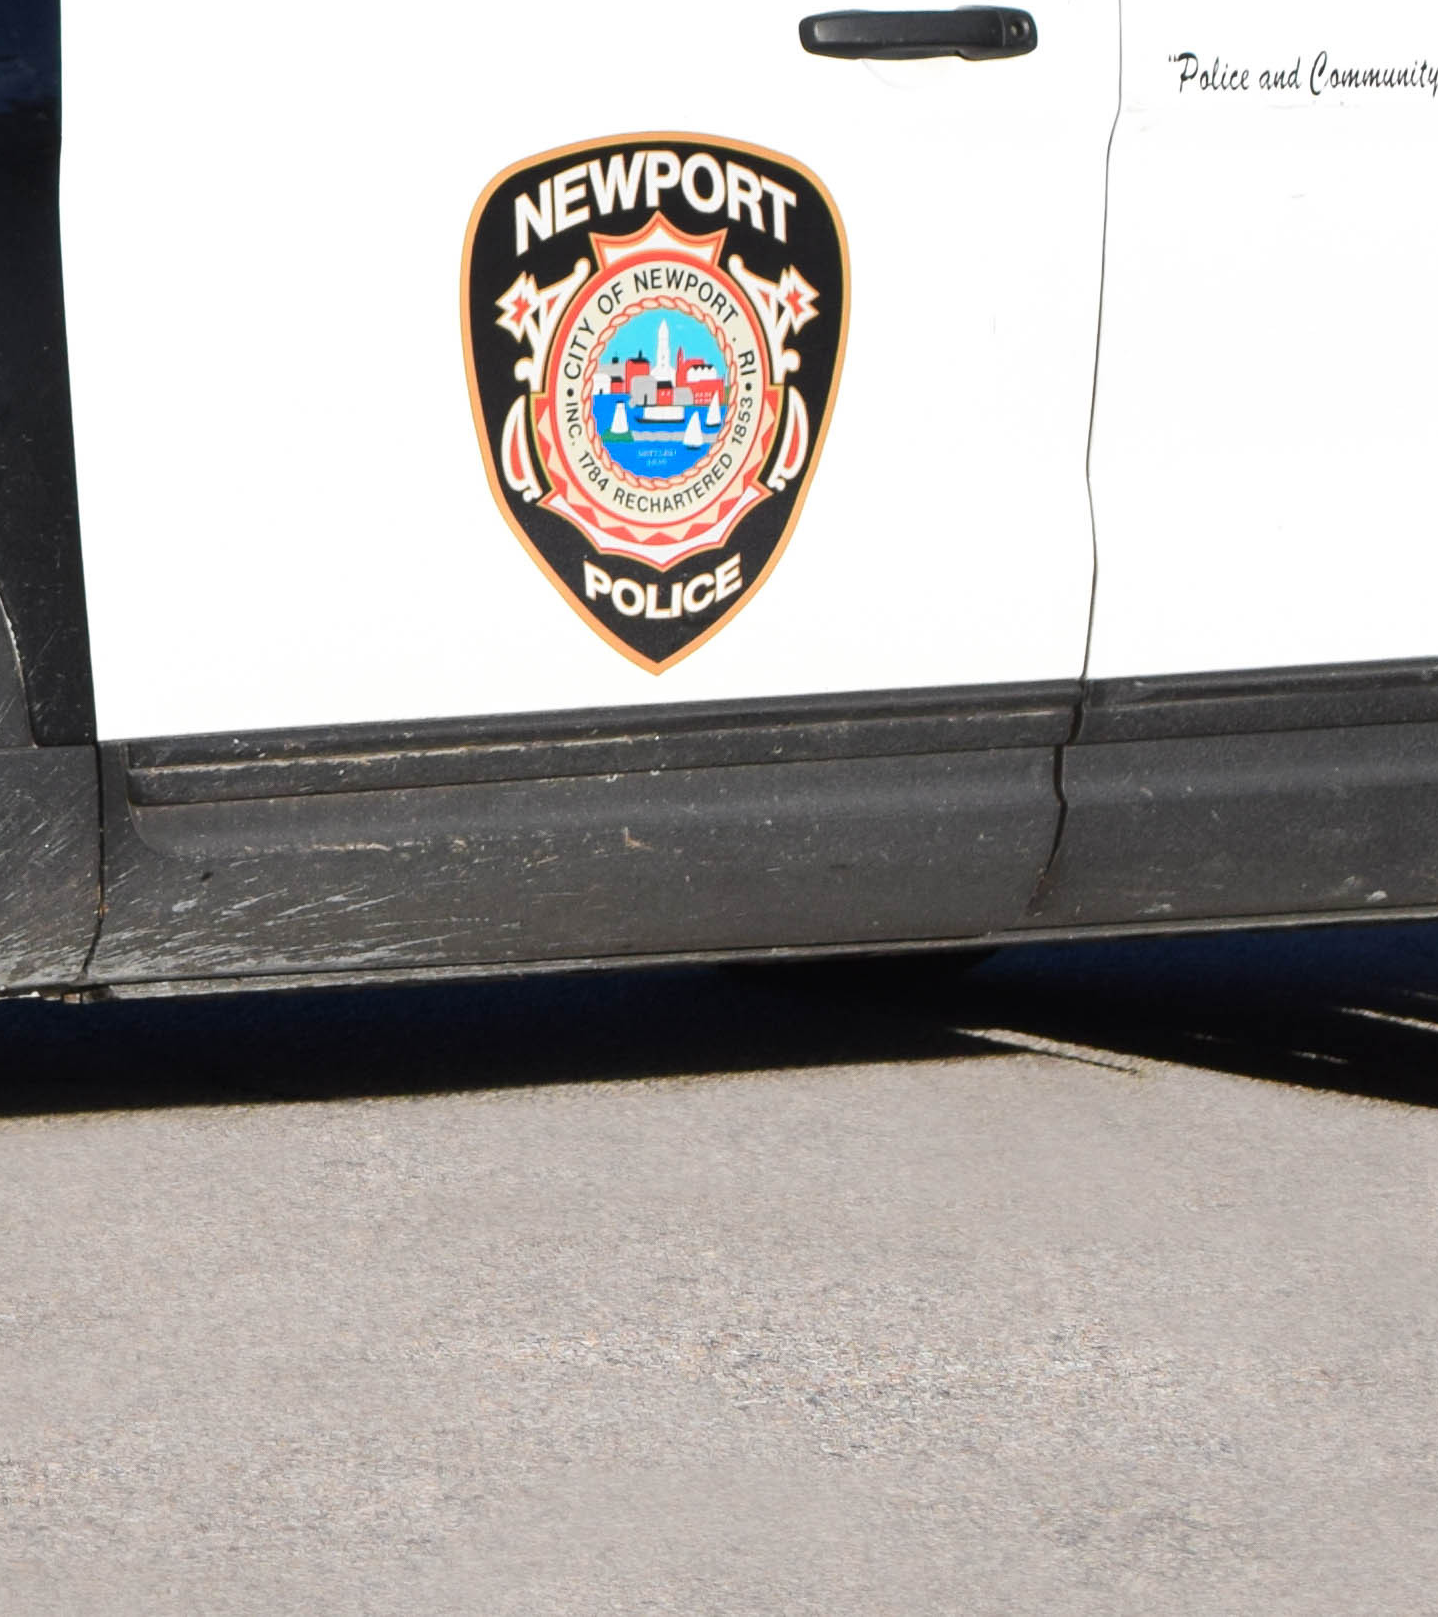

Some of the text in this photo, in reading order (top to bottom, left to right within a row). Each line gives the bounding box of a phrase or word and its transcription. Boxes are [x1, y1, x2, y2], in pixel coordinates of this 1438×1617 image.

[1259, 56, 1301, 90] and
[514, 150, 797, 257] NEWPORT
[564, 267, 757, 380] CITY OF NEWPORT RI
[566, 396, 753, 513] INC. 1784 RECHARTERED 1853
[583, 552, 743, 619] POLICE
